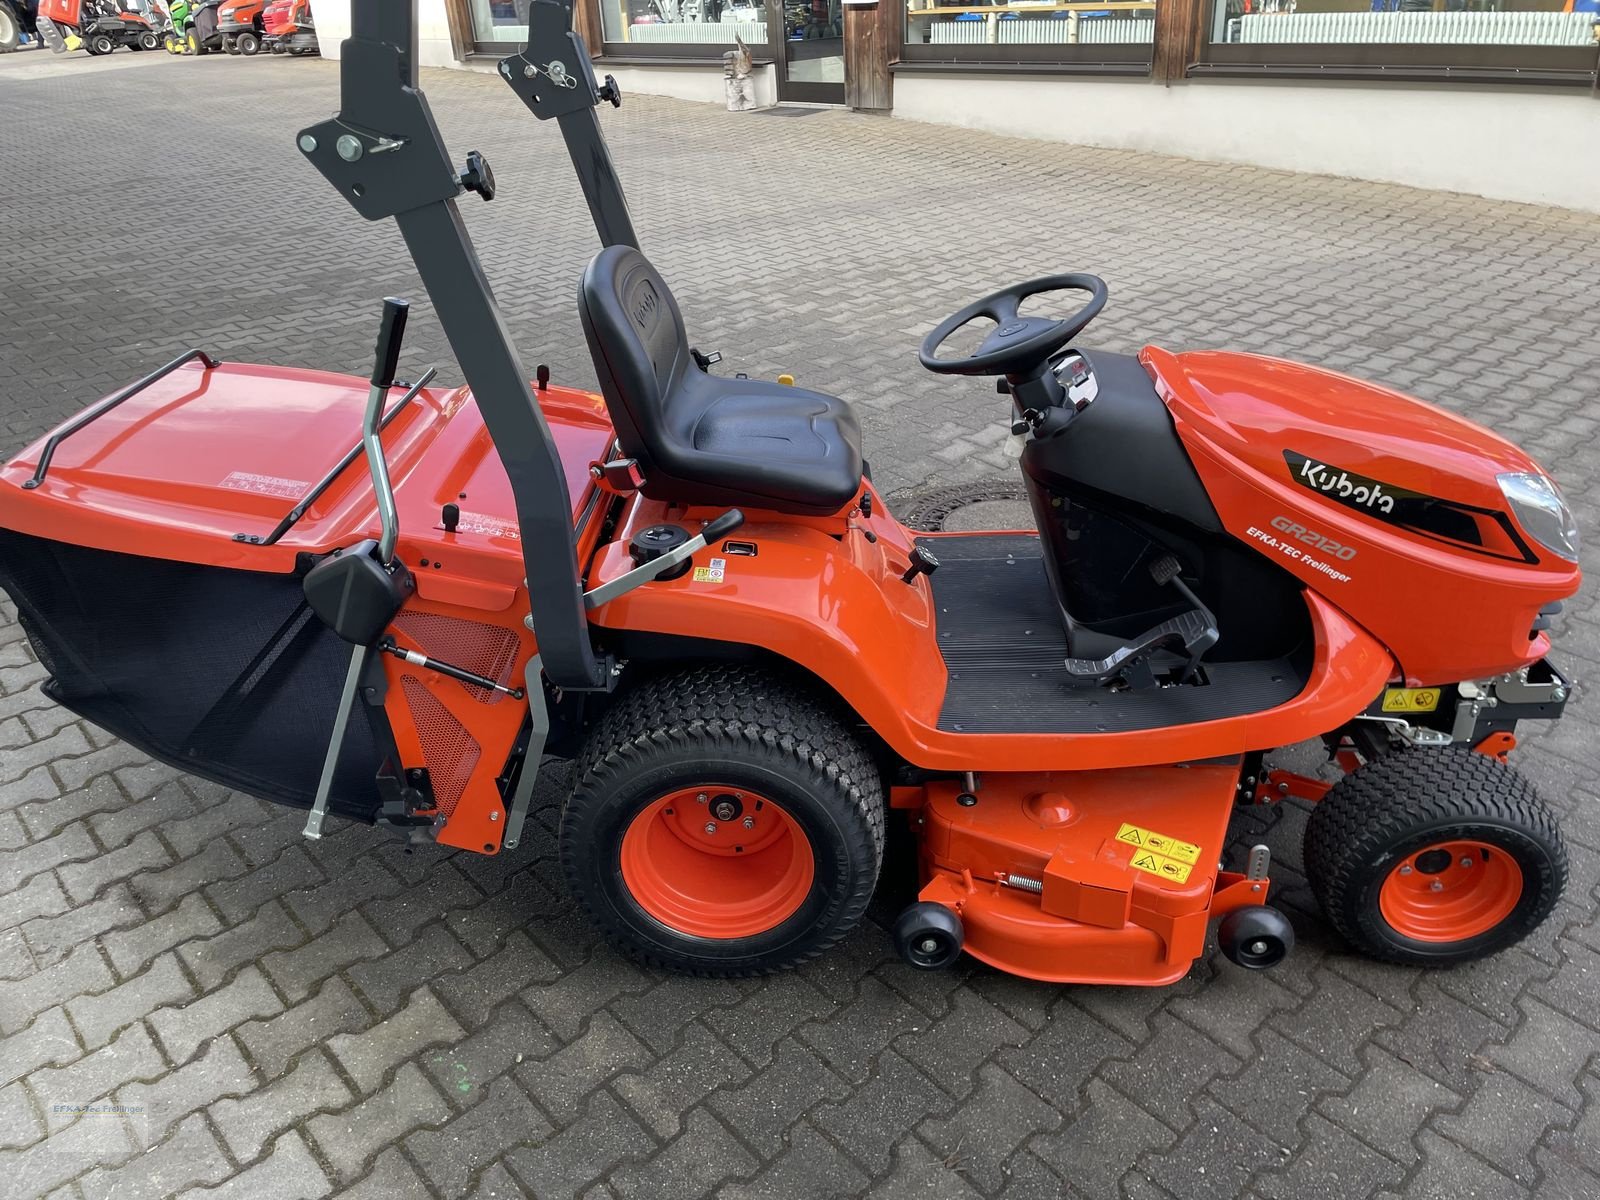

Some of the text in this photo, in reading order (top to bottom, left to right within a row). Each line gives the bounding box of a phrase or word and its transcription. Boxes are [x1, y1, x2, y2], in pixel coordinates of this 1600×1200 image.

[1300, 459, 1394, 514] Kubota
[1246, 526, 1352, 582] EFKA-TEC Freilinger
[1270, 515, 1357, 561] GR2120
